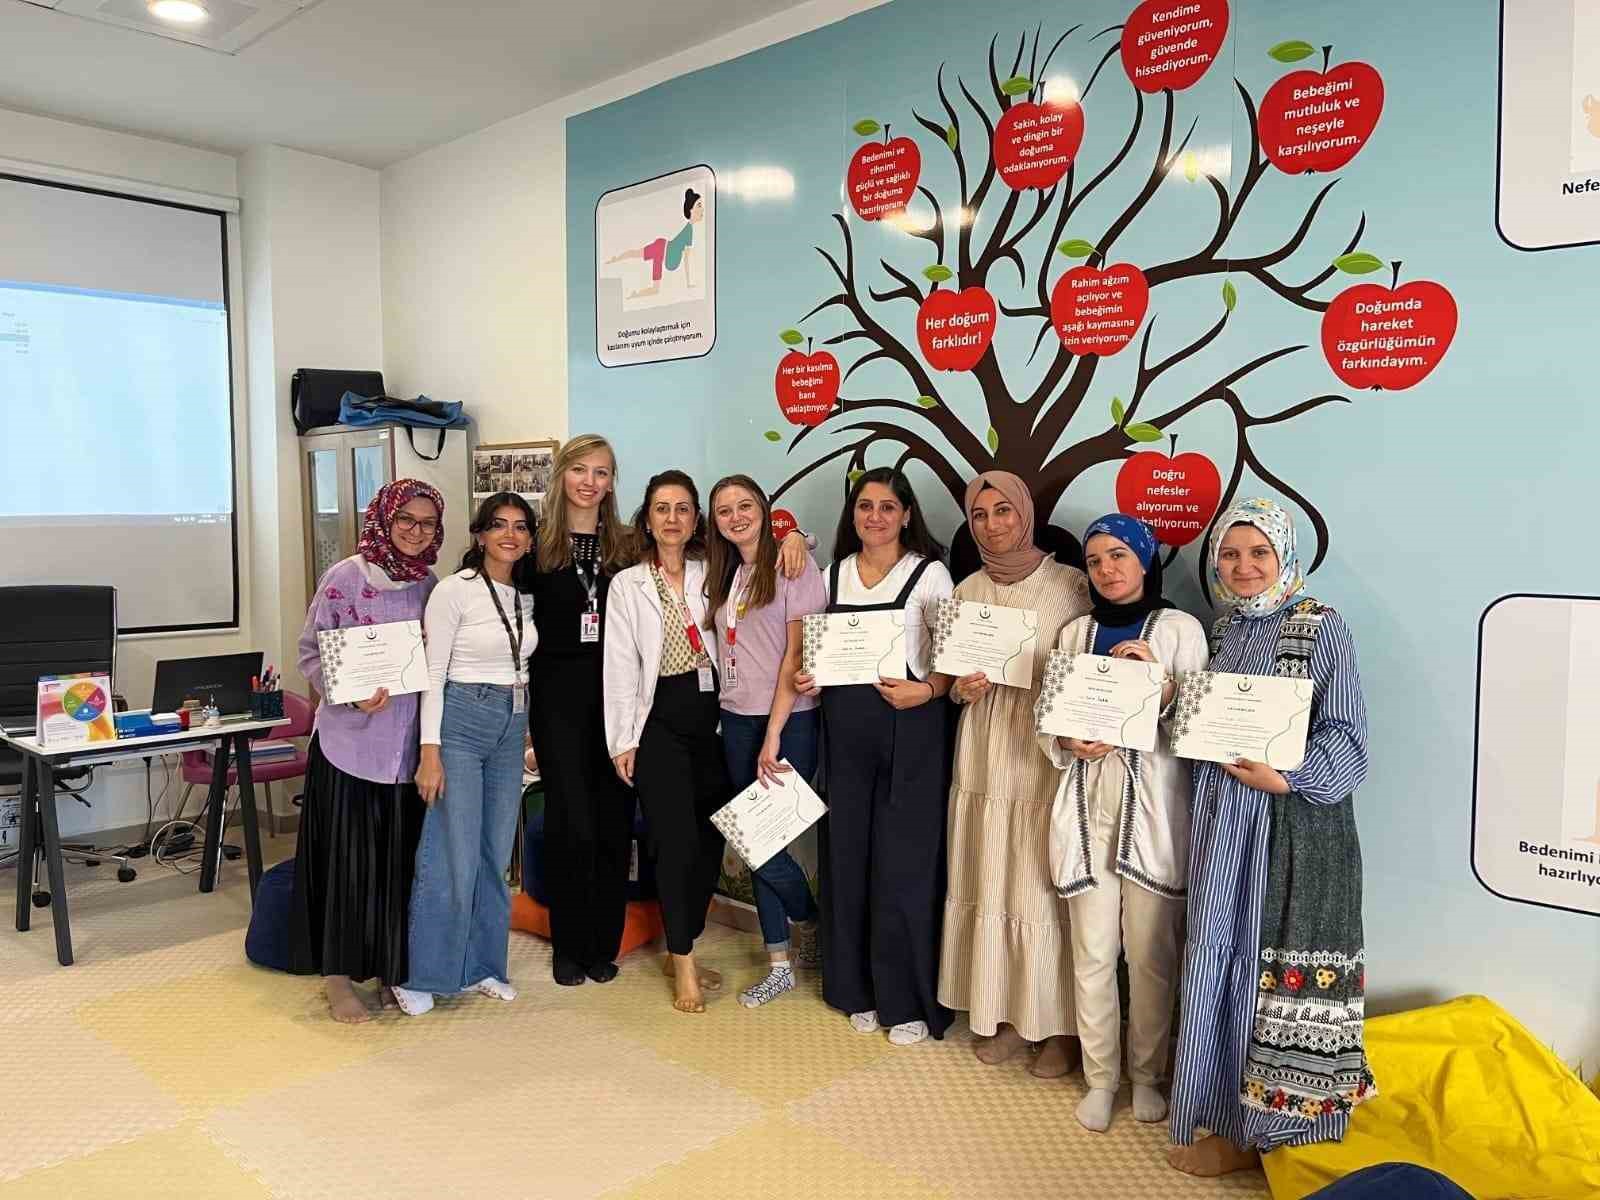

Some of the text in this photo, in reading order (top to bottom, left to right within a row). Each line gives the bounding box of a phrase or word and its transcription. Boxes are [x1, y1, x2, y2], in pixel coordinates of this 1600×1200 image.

[1152, 4, 1200, 23] Kendime
[1137, 19, 1213, 46] güveniyorum,
[1150, 38, 1198, 60] güvende
[1135, 53, 1212, 77] hissediyorum.
[1293, 78, 1353, 100] Bebeğimi
[1284, 98, 1360, 120] mutluluk ve
[1013, 113, 1063, 130] Sakin, kolay
[1296, 117, 1344, 136] neşeyle
[1012, 126, 1064, 144] ve dingin bir
[1019, 144, 1054, 157] doğuma
[1278, 135, 1360, 157] karşılıyorum.
[861, 147, 905, 164] Bedenimi ve
[1003, 155, 1069, 173] odaklanıyorum.
[863, 188, 903, 202] bir doğuma
[1562, 179, 1600, 195] Nefe
[1072, 275, 1129, 288] Rahim ağzım
[1076, 291, 1123, 303] açılıyor ve
[1075, 304, 1123, 317] bebeğimin
[1355, 298, 1422, 315] Doğumda
[925, 312, 989, 330] Her doğum
[1062, 319, 1135, 332] aşağı kaymasına
[1361, 318, 1414, 332] hareket
[932, 331, 982, 349] farklıdır!
[1064, 334, 1130, 345] izin veriyorum.
[1337, 336, 1436, 353] özgürlüğümün
[782, 362, 833, 375] Her bir kasılma
[1342, 356, 1428, 369] farkındayım.
[791, 376, 823, 387] bebeğimi
[799, 391, 816, 400] bana
[1152, 469, 1185, 481] Doğru
[1147, 485, 1190, 496] nefesler
[1136, 502, 1200, 514] alıyorum ve
[1519, 841, 1594, 864] Bedenimi
